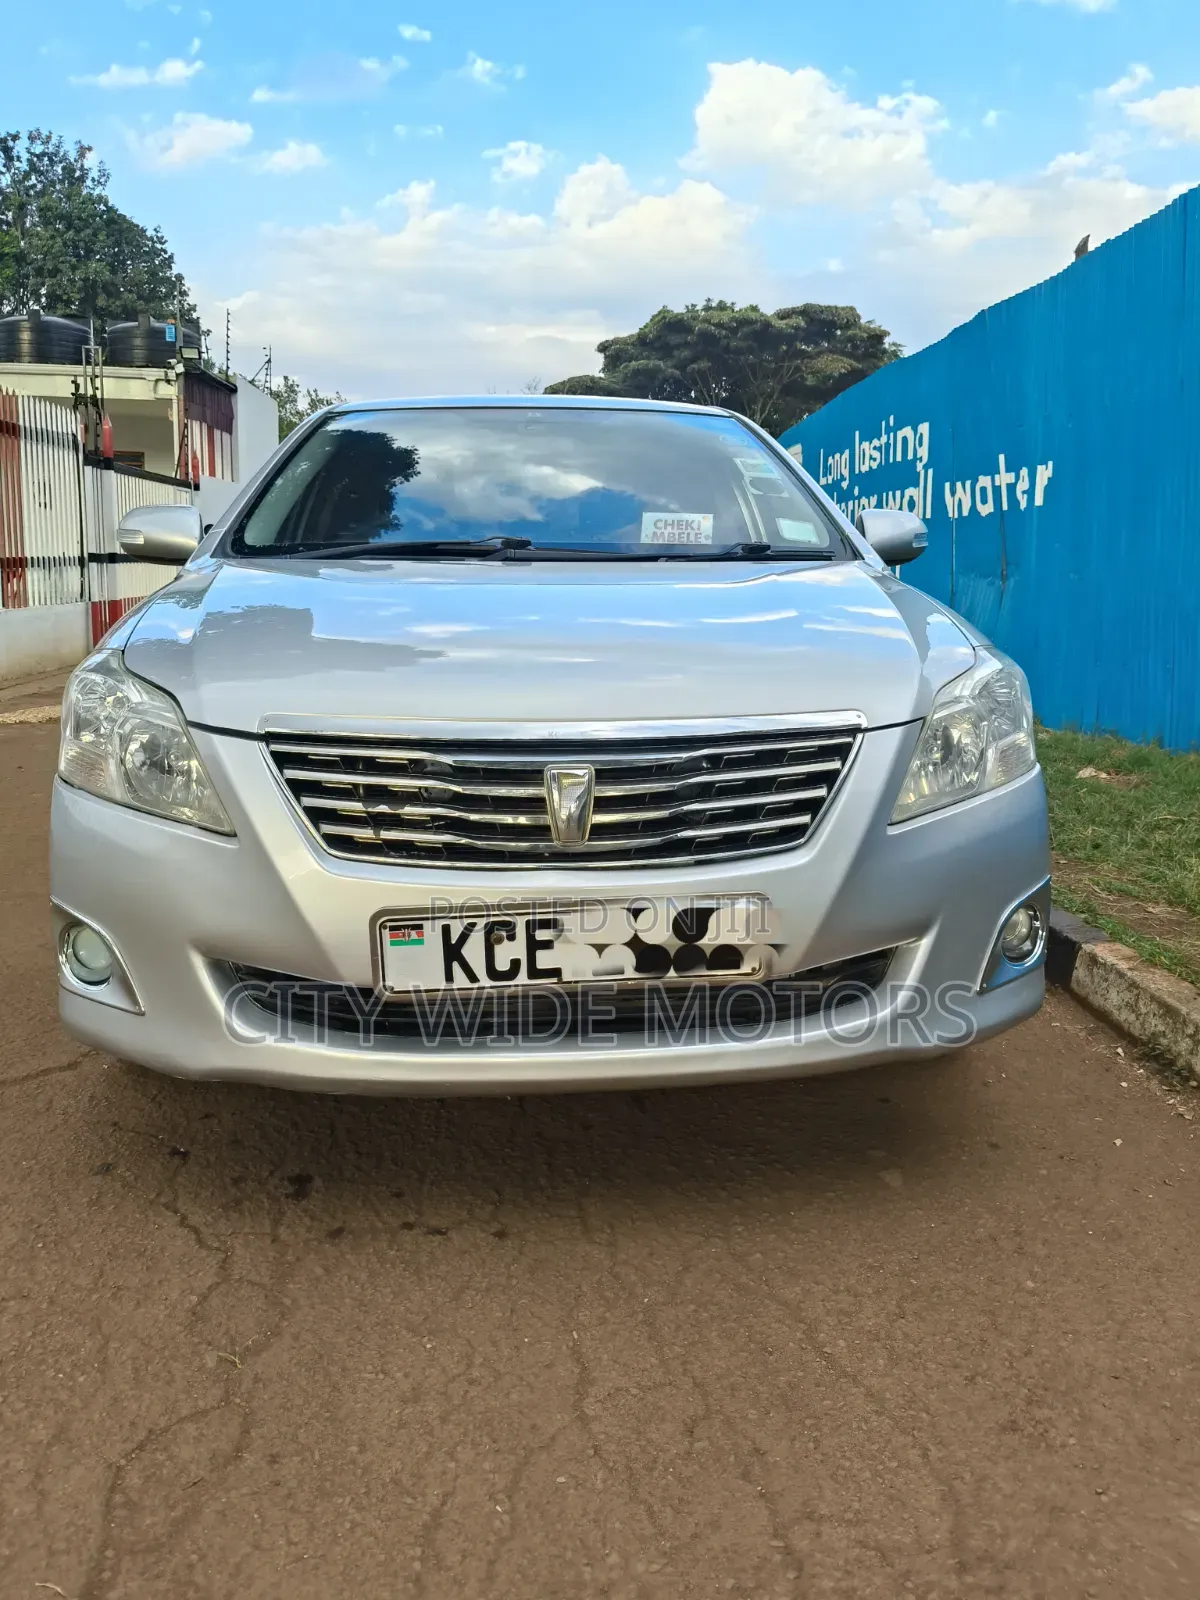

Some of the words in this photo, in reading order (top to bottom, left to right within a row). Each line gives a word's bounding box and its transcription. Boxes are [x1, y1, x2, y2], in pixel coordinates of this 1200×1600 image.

[819, 448, 849, 490] Long
[855, 414, 930, 471] lasting
[944, 453, 1053, 520] water
[650, 531, 702, 544] MBELE
